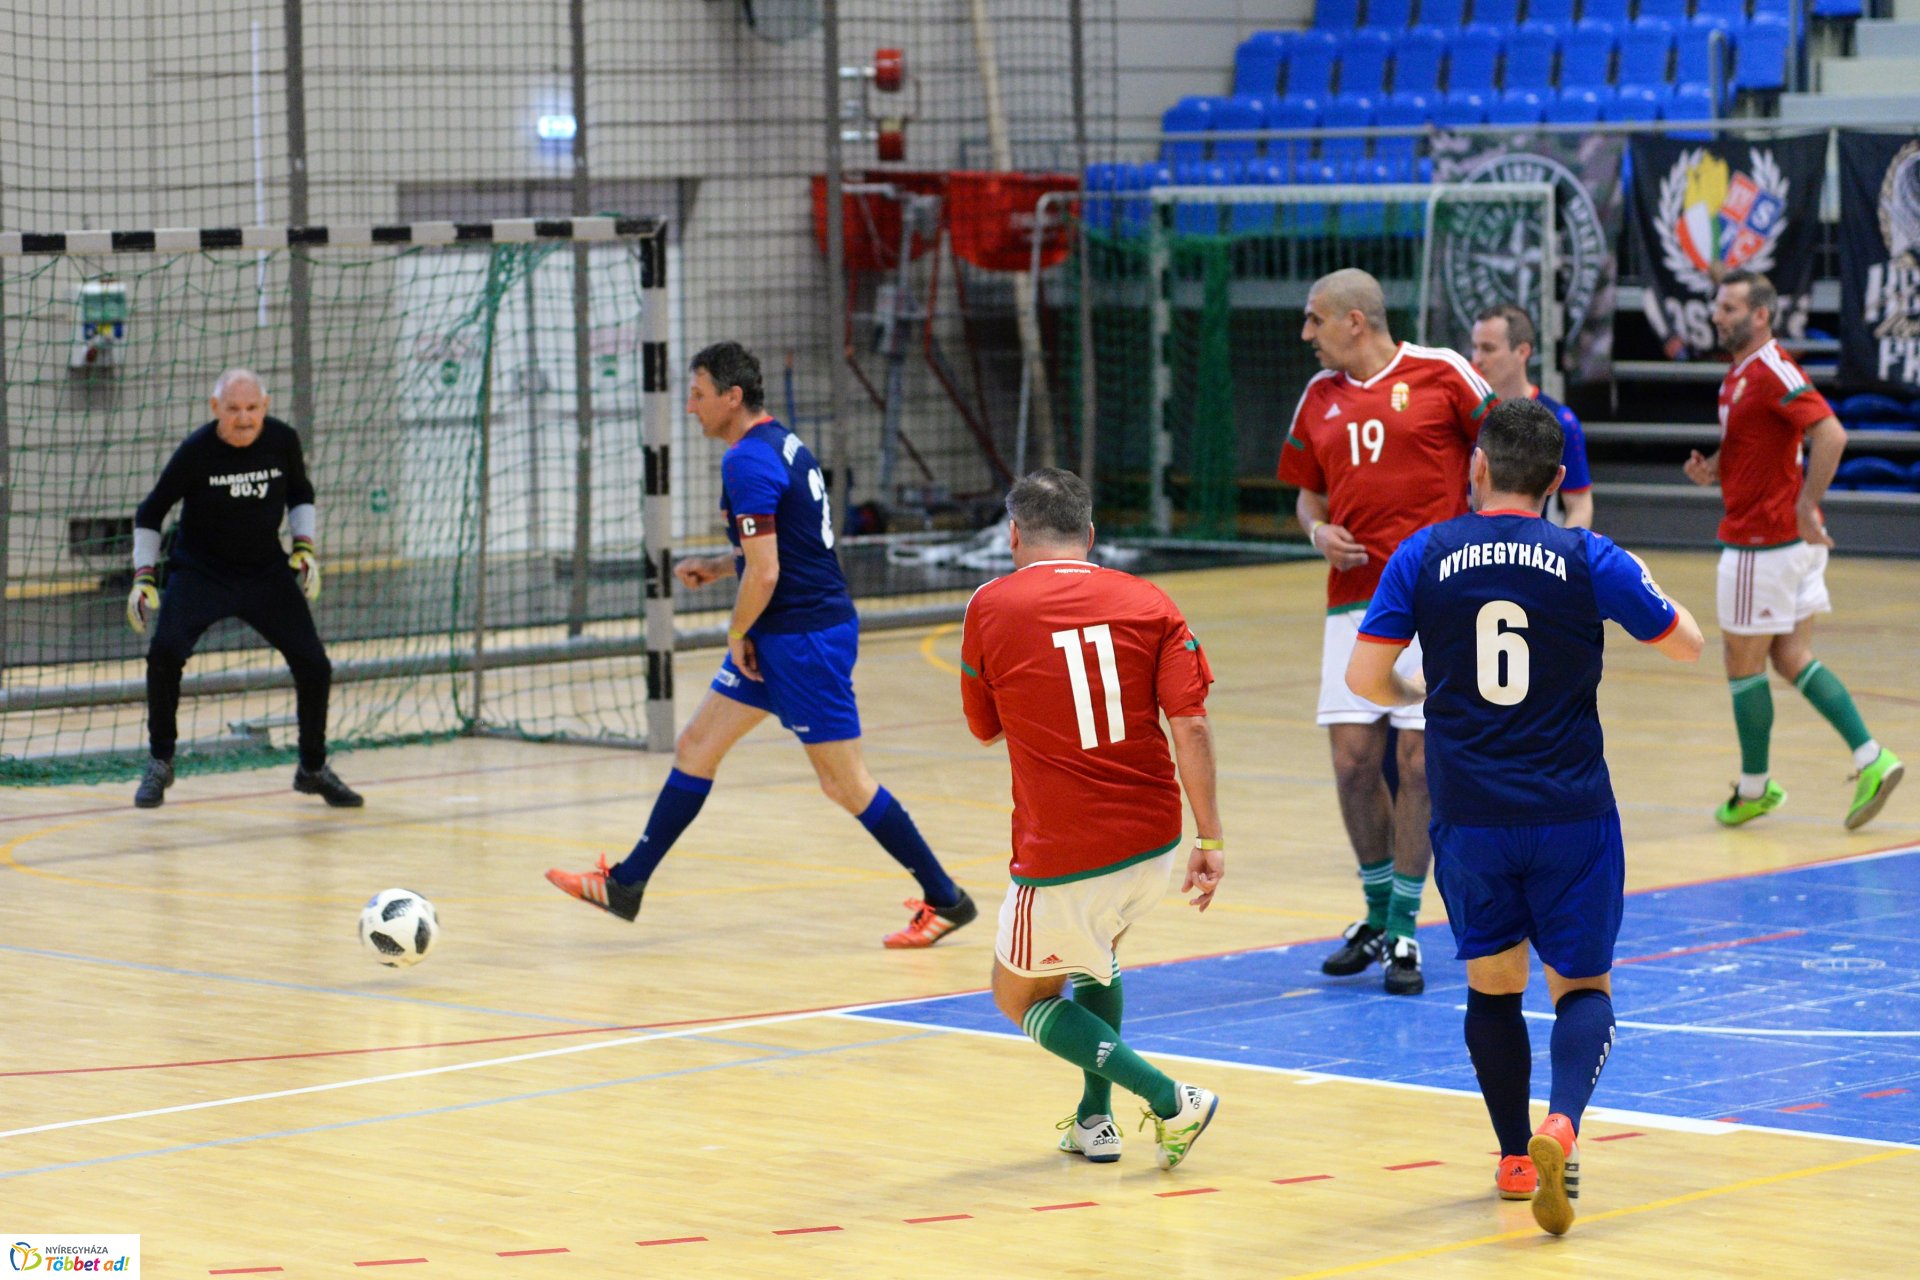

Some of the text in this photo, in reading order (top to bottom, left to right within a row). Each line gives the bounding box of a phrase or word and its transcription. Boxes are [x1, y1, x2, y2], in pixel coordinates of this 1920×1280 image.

[1346, 418, 1386, 467] 19
[209, 470, 269, 486] HARGITAI
[742, 517, 757, 536] C
[1439, 541, 1567, 582] NYÍREGYHÁZA
[1475, 599, 1530, 707] 6
[1051, 623, 1126, 751] 11
[1092, 1137, 1120, 1146] adida
